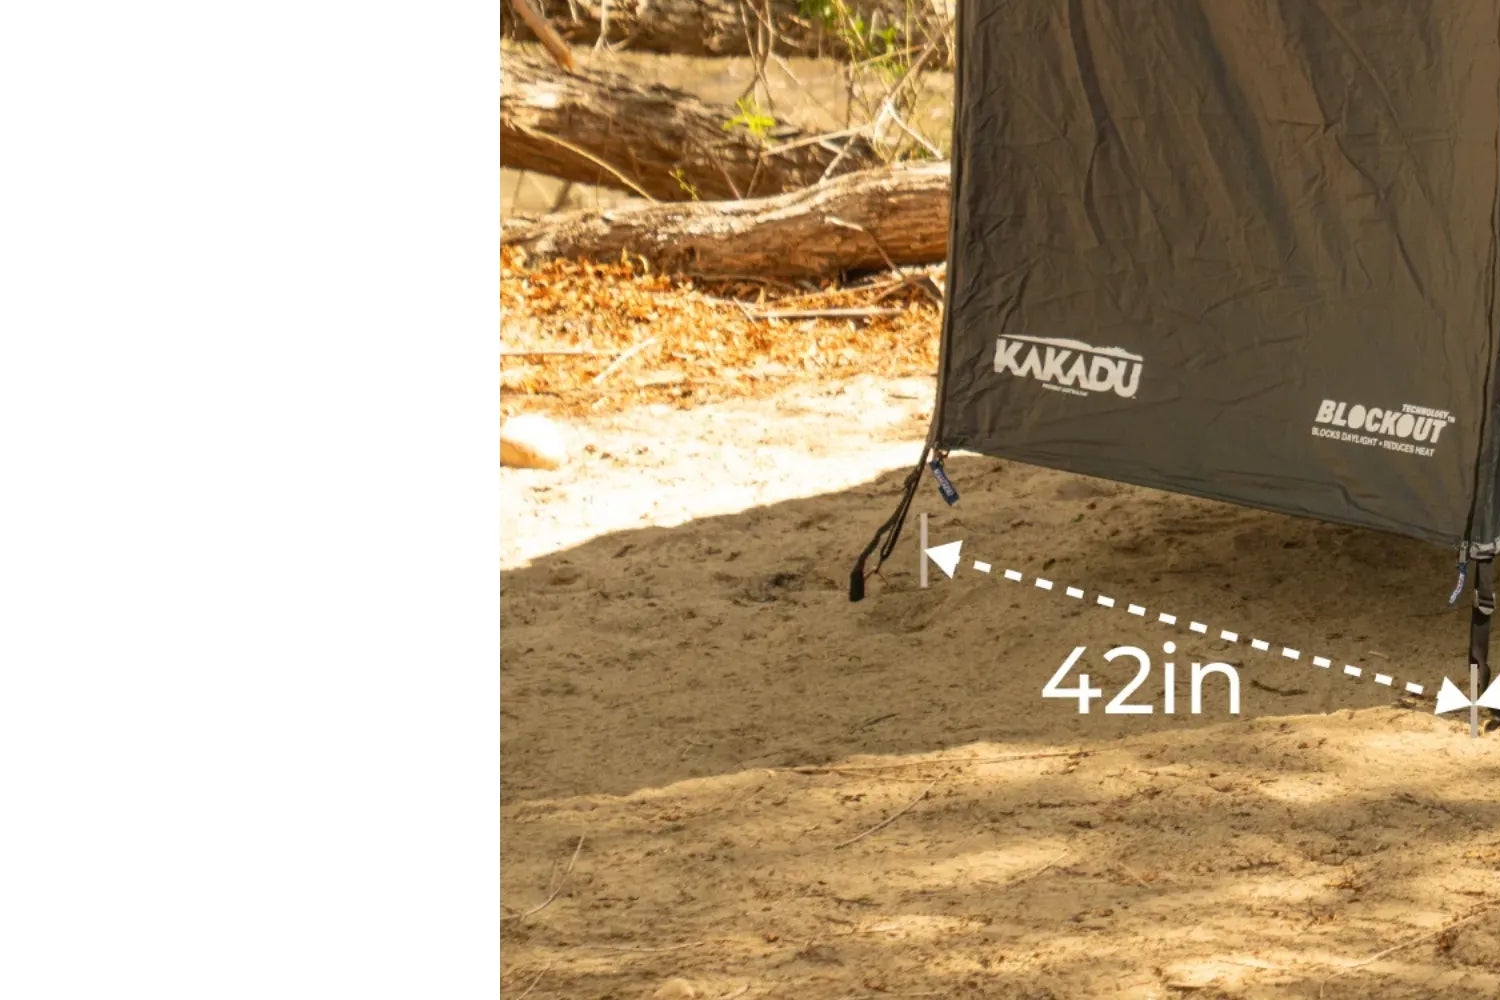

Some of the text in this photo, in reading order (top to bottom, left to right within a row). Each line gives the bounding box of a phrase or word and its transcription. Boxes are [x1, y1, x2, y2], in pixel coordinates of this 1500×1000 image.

[994, 338, 1143, 398] KAKADU
[1312, 426, 1436, 457] BLOCKS DAYLIGHT REDUCES HEAT
[1315, 400, 1447, 443] BLOCKOUT
